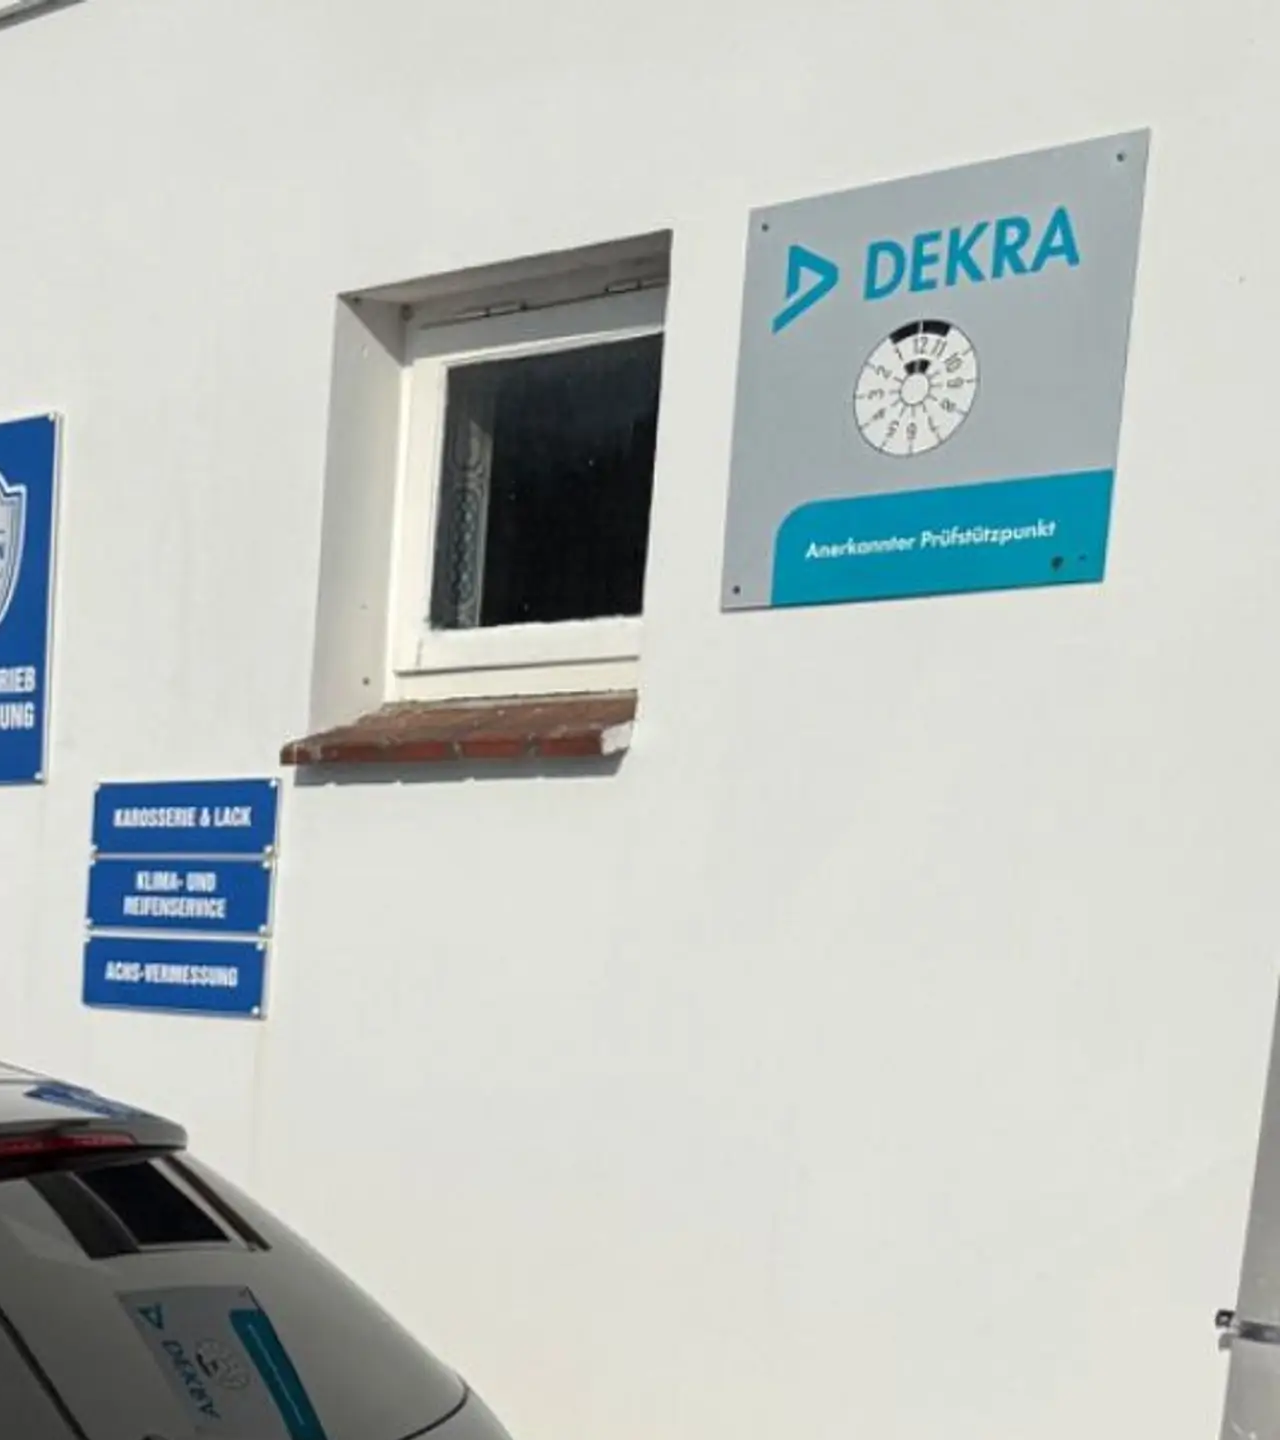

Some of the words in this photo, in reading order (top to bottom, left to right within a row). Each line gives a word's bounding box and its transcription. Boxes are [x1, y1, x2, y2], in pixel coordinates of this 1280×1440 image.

[862, 204, 1080, 301] DEKRA
[805, 534, 916, 560] Anerkannter
[920, 519, 1057, 549] Prüfstützpunkt
[113, 808, 196, 828] KAROSSERIE
[199, 807, 212, 827] &
[214, 806, 252, 827] LACK
[135, 871, 183, 891] KLIMA-
[186, 872, 217, 892] UND
[123, 896, 227, 919] REIFENSERVICE
[105, 961, 238, 987] ACHS-VERMESSUNG
